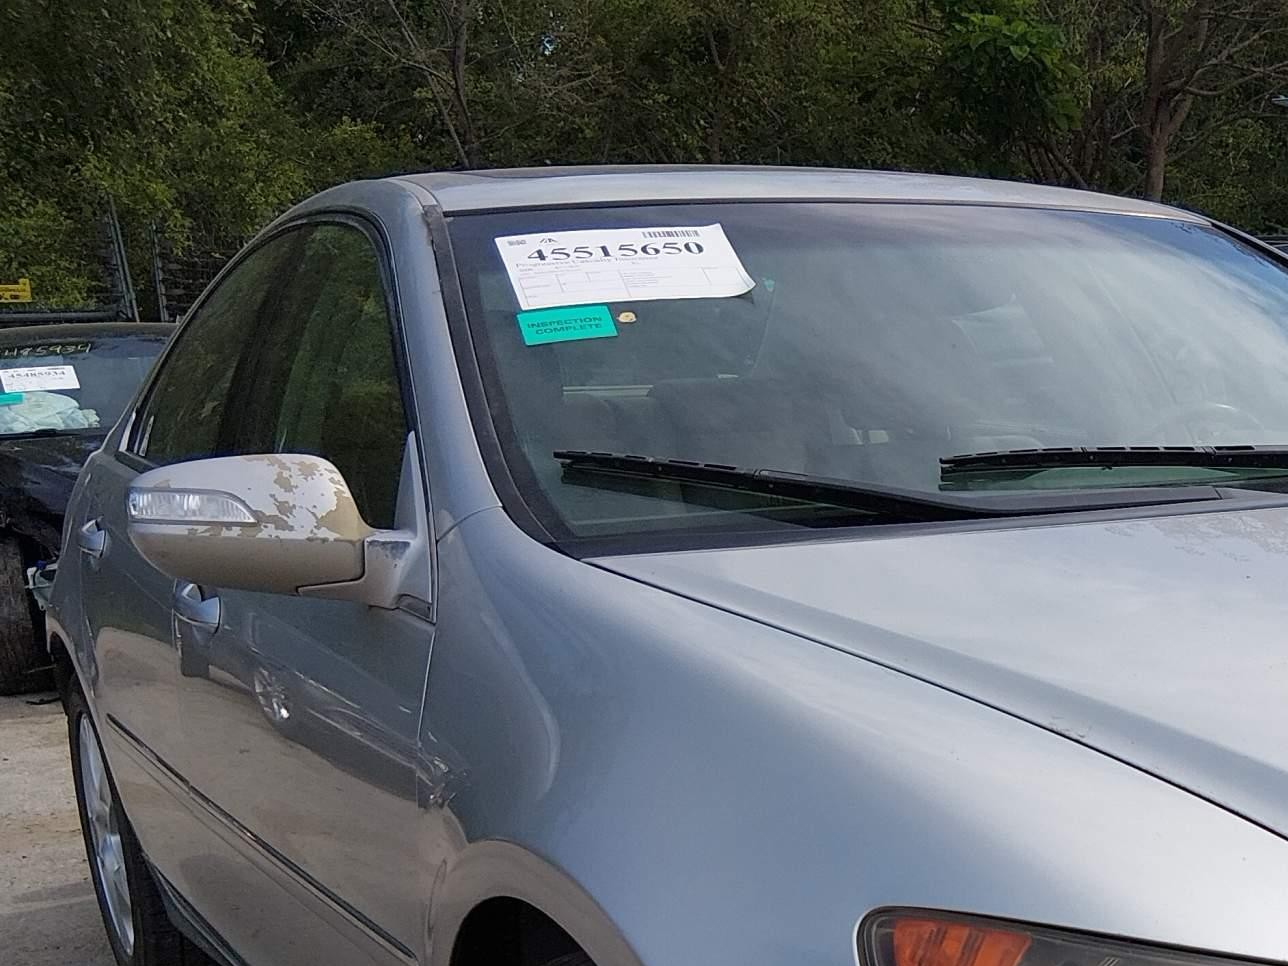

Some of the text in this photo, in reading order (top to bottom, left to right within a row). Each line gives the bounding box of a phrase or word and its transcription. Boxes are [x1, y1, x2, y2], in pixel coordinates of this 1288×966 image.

[527, 241, 705, 262] 45515650
[527, 316, 602, 328] INSPECTION
[535, 323, 602, 335] COMPLETE
